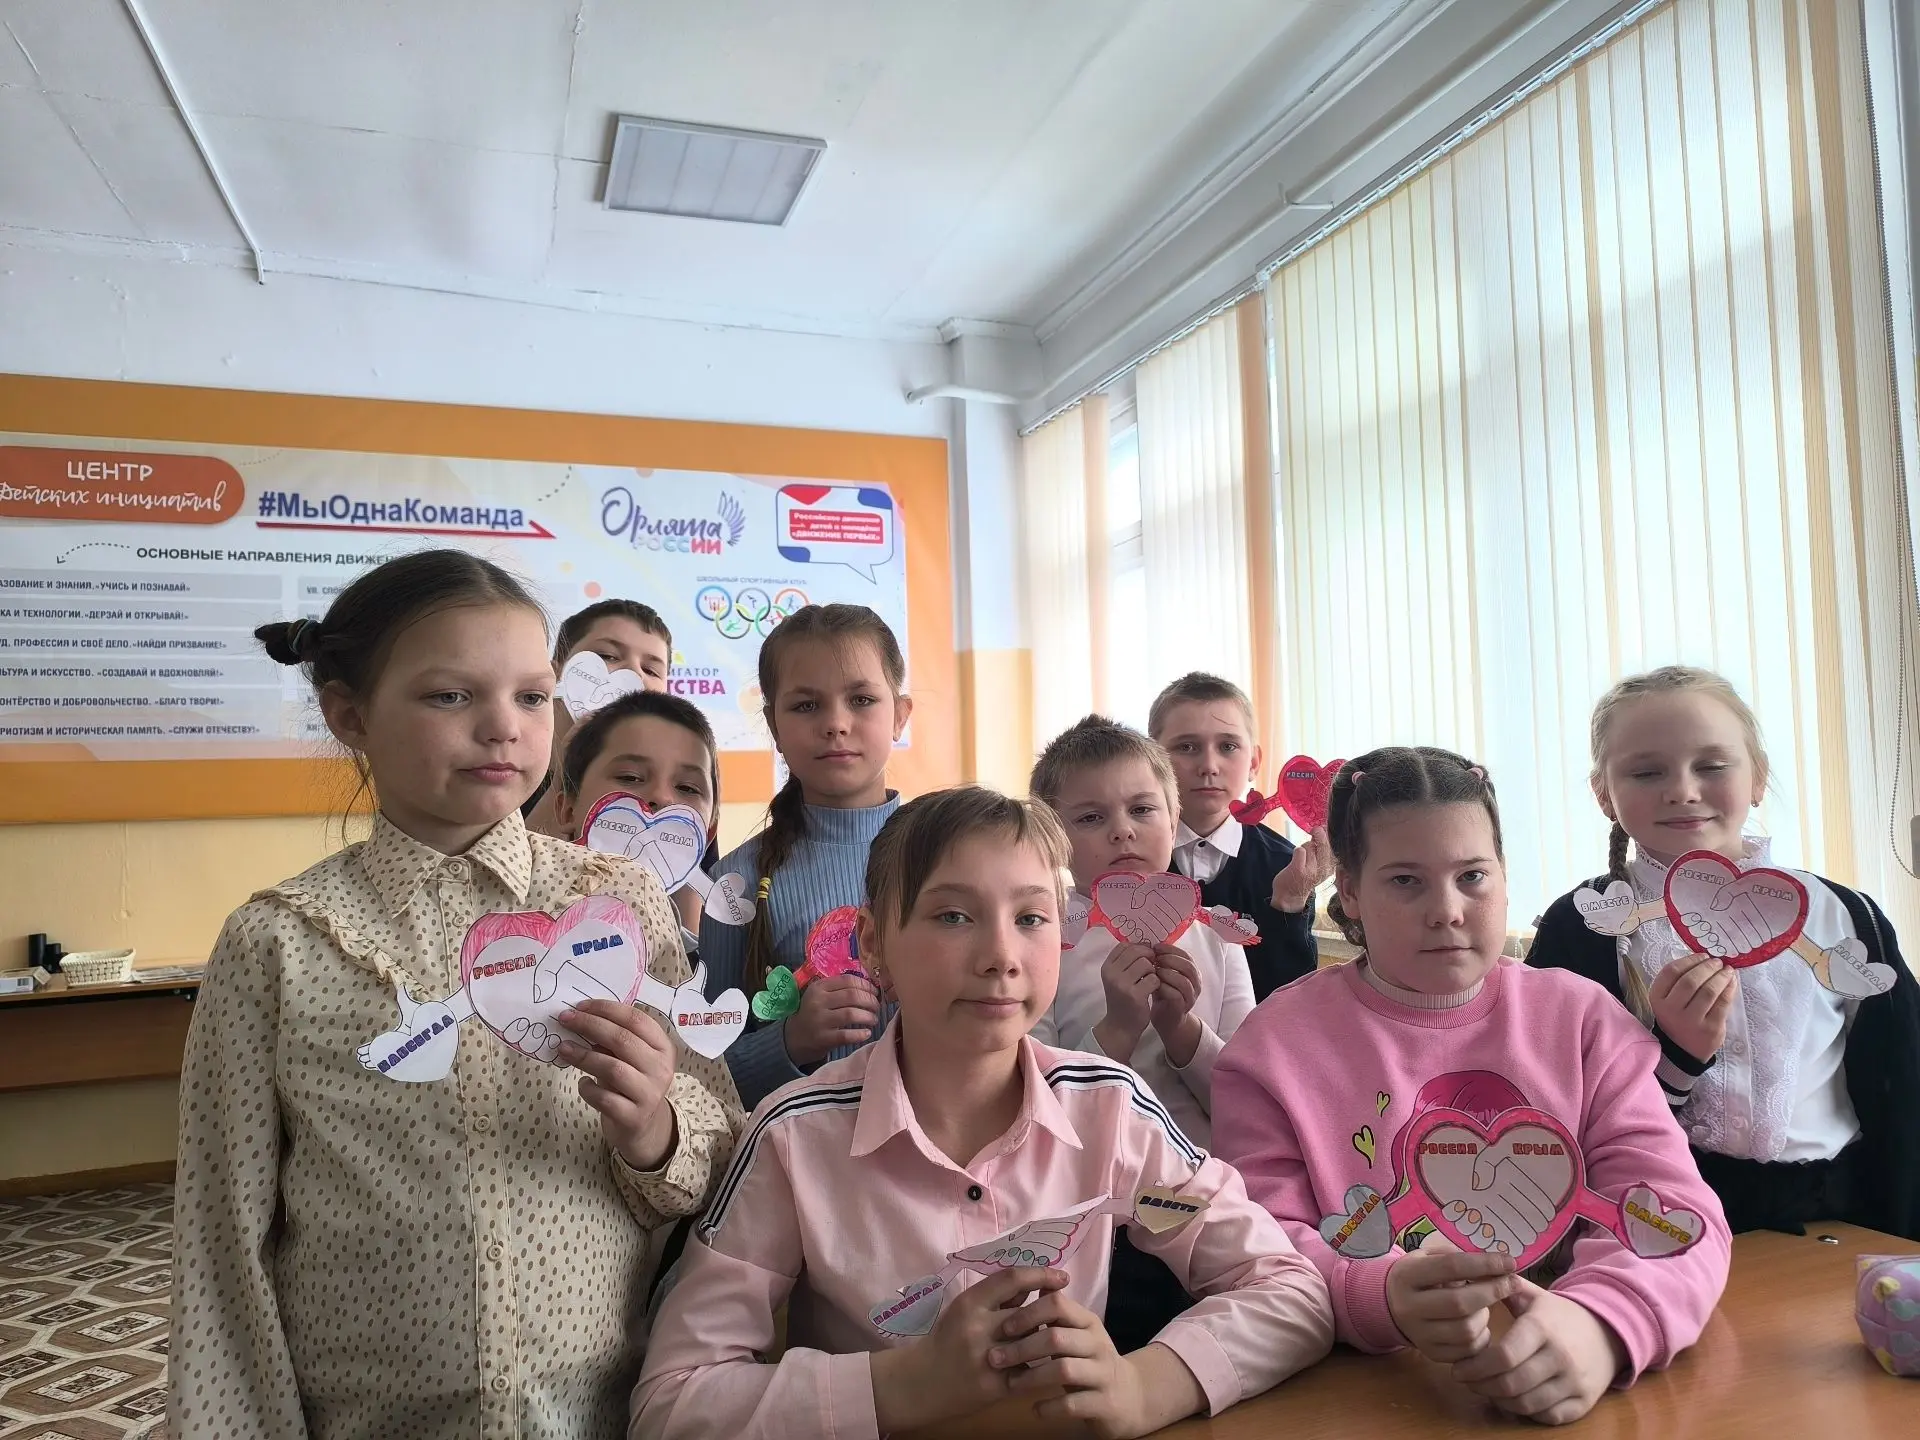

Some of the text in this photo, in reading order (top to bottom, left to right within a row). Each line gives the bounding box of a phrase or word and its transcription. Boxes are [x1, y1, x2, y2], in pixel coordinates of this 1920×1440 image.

[67, 461, 153, 482] ЦЕНТР
[0, 480, 227, 512] Детских инициатив
[259, 491, 524, 530] #МыОднаКоманда
[136, 547, 223, 562] ОСНОВНЫЕ
[227, 550, 332, 564] НАПРАВЛЕНИЯ
[0, 579, 45, 589] АЗОВАНИЕ
[46, 580, 53, 589] И
[131, 582, 138, 591] И
[13, 609, 20, 617] И
[125, 611, 132, 619] И
[14, 638, 70, 648] ПРОФЕССИЯ
[71, 639, 78, 648] И
[80, 637, 104, 648] СВОЁ
[31, 668, 38, 677] И
[150, 669, 157, 677] И
[671, 667, 720, 677] ИГАТОР
[667, 679, 726, 695] ТСТВА
[0, 695, 51, 706] ОНТЁРСТВО
[53, 697, 60, 706] И
[0, 727, 44, 736] РИОТИЗМ
[46, 727, 53, 736] И
[55, 726, 124, 736] ИСТОРИЧЕСКАЯ
[594, 818, 638, 835] РОССИЯ
[659, 831, 695, 848] КРЫМ
[1157, 882, 1191, 890] КРЫМ
[1676, 867, 1794, 902] РОССИЯ КРЫМ
[719, 879, 743, 922] ВМЕСТЕ
[1580, 895, 1630, 913] ВМЕСТЕ
[571, 933, 625, 957] КРЫМ
[473, 954, 537, 980] РОССИЯ
[1833, 943, 1888, 993] НАВСЕГДА
[678, 1010, 743, 1027] ВМЕСТЕ
[376, 1013, 455, 1074] НАВСЕГДА
[1419, 1142, 1565, 1156] РОССИЯ КРЫМ
[1330, 1193, 1381, 1250] НАВСЕГДА
[1624, 1200, 1692, 1245] ВМЕСТЕ
